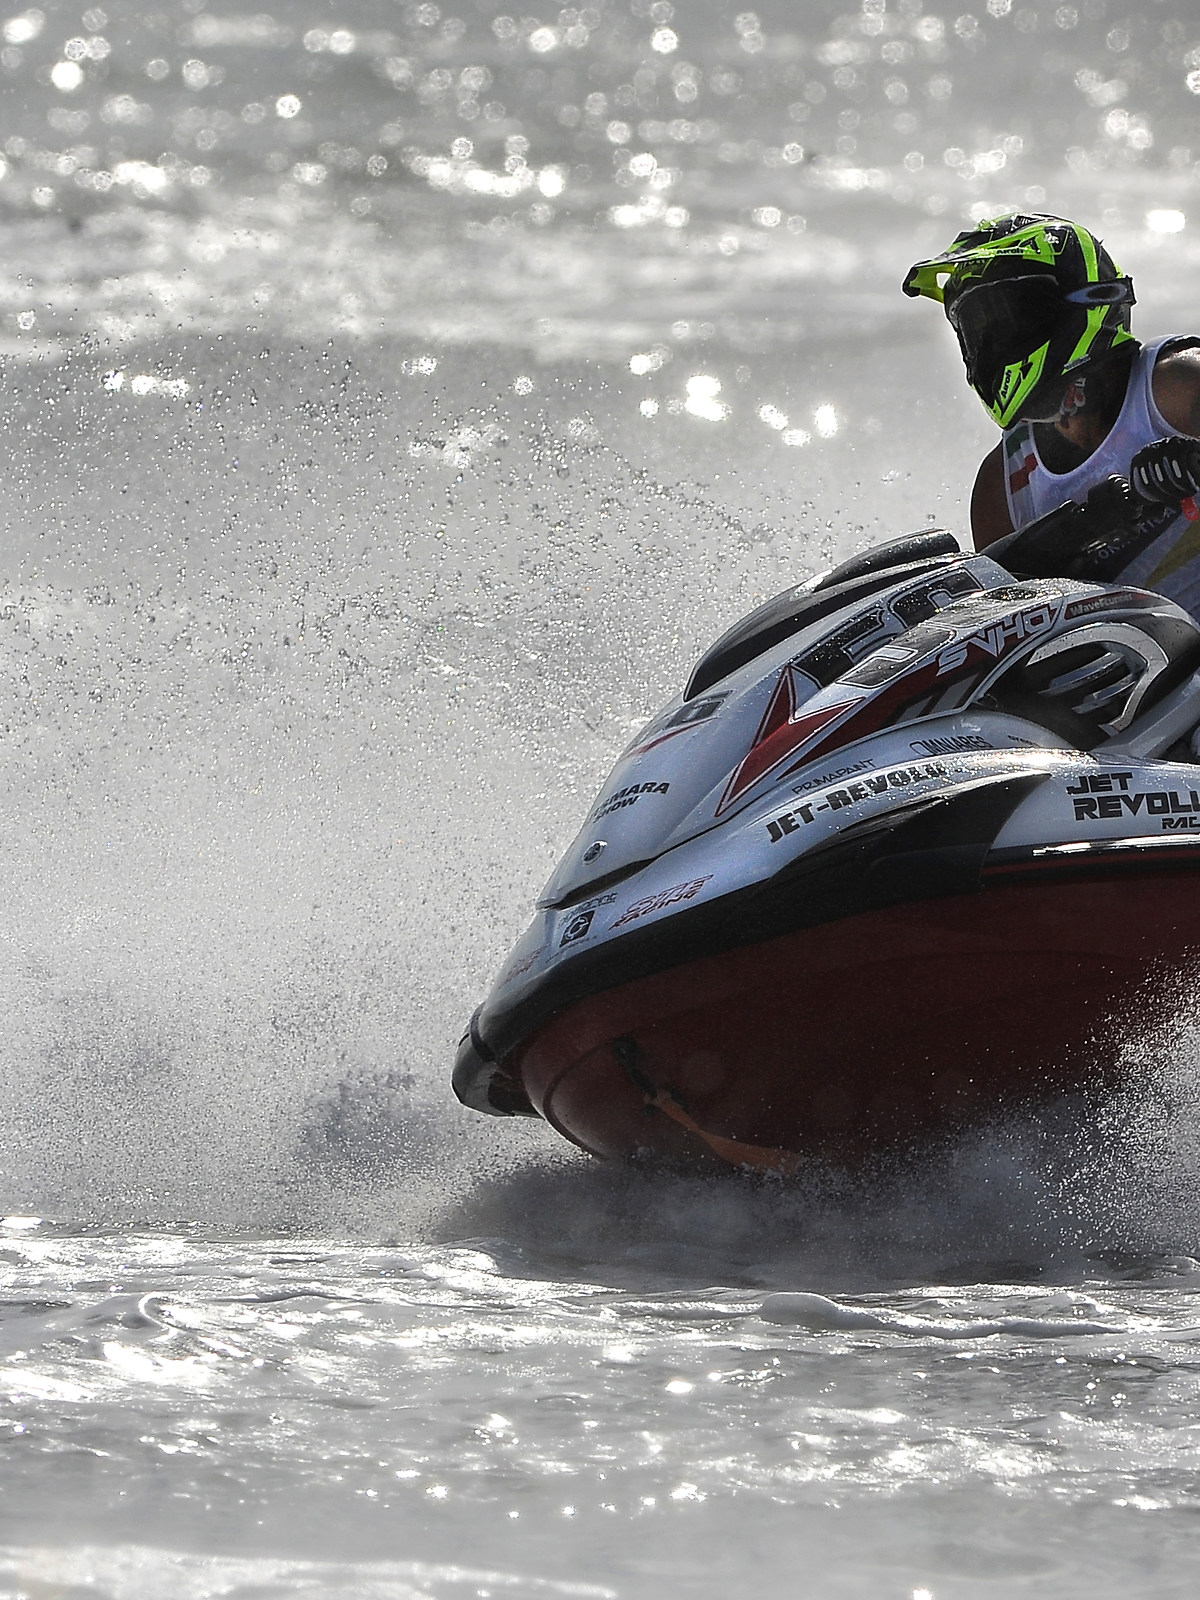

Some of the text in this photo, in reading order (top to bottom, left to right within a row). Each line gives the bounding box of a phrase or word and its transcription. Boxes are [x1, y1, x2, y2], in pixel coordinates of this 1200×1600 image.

[1070, 592, 1134, 617] WaveRunner
[936, 605, 1052, 677] SVHO
[1066, 772, 1133, 795] JET
